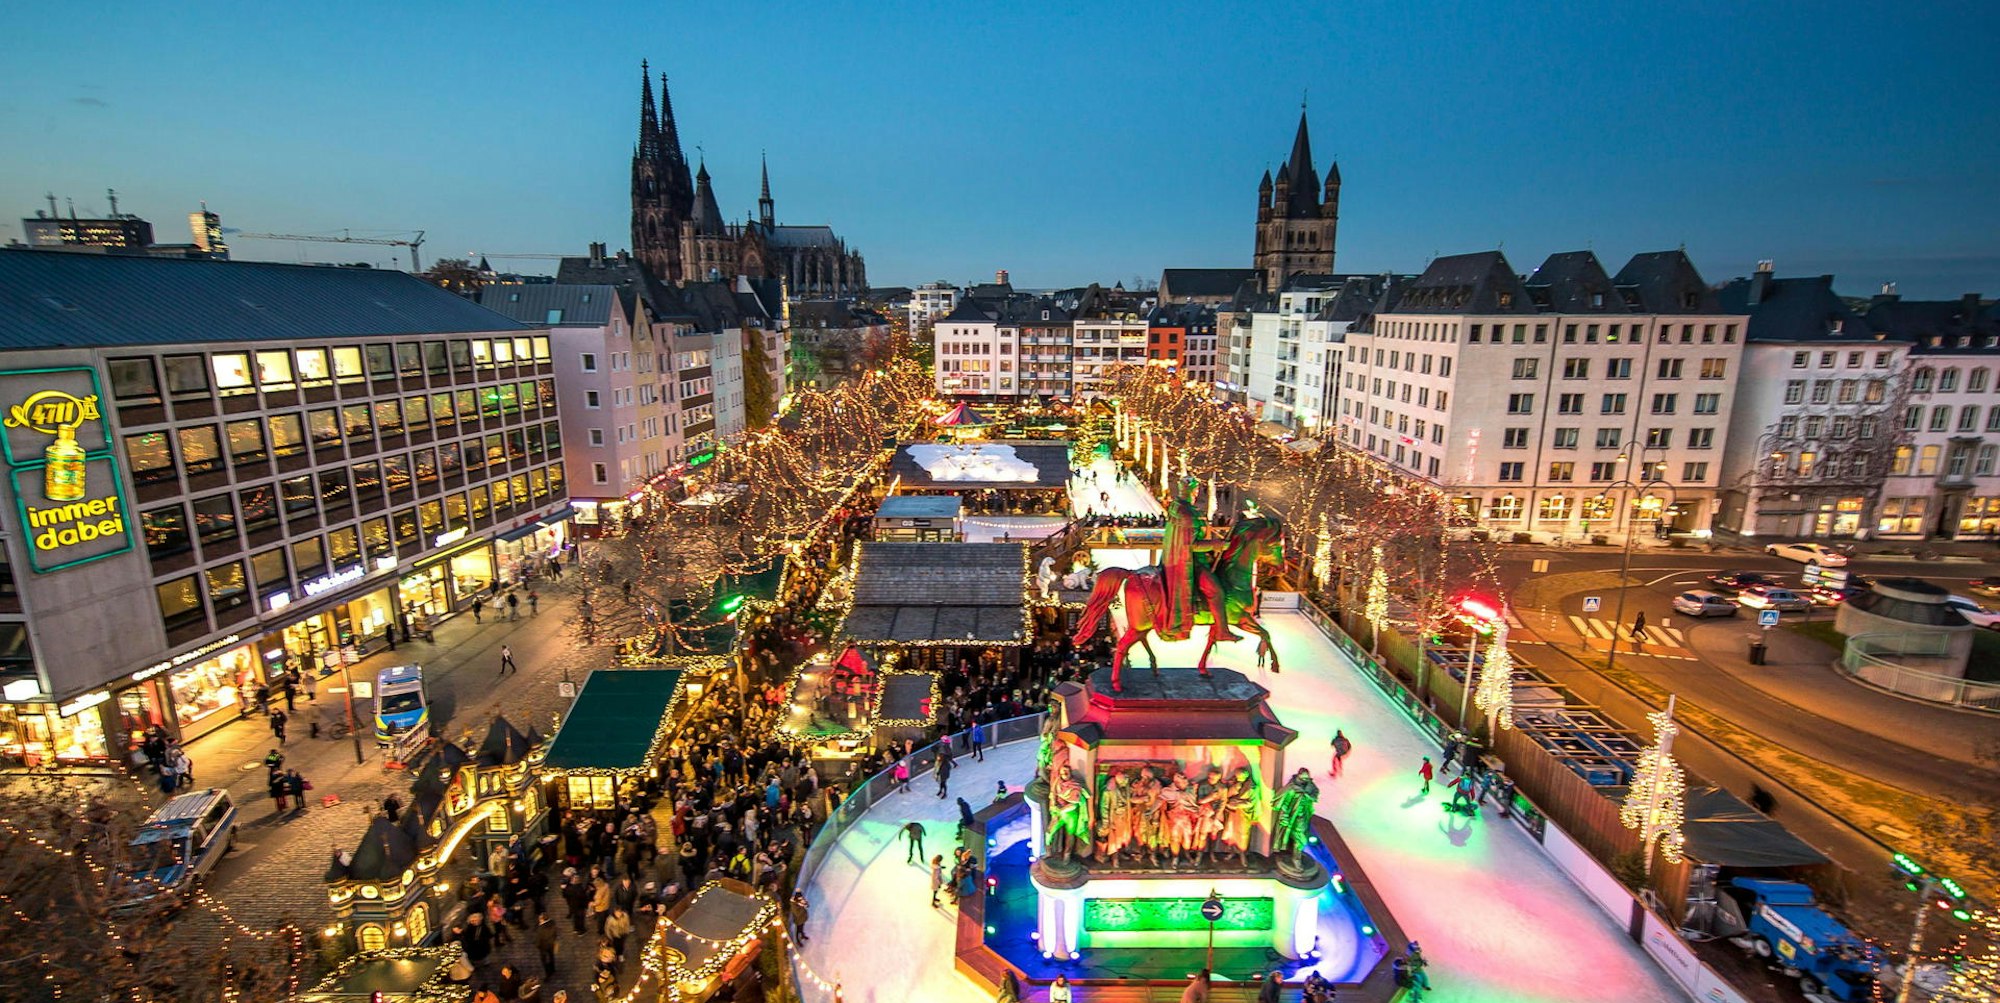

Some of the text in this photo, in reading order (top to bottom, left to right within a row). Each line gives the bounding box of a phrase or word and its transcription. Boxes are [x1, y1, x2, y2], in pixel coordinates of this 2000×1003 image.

[32, 401, 74, 425] 4711
[28, 496, 118, 528] immer
[36, 514, 124, 551] dabei
